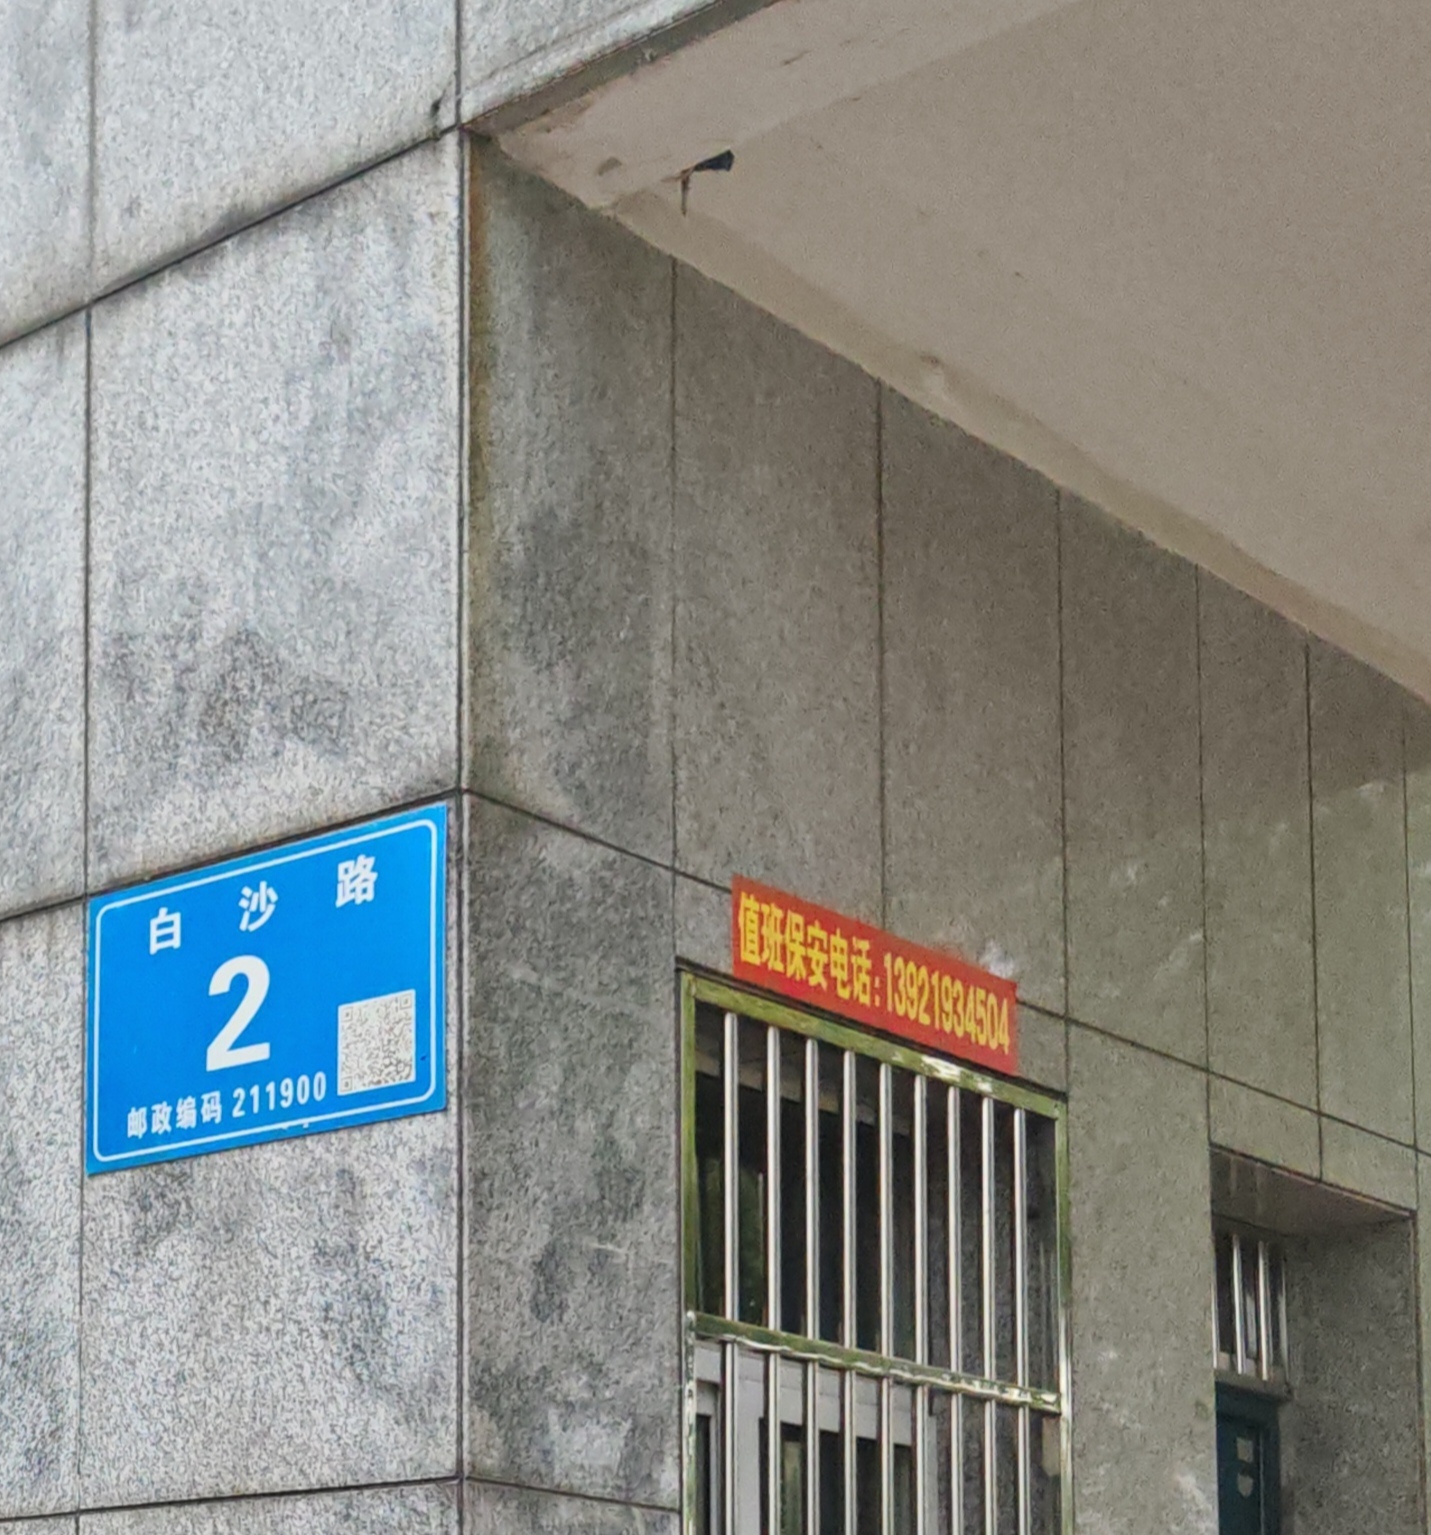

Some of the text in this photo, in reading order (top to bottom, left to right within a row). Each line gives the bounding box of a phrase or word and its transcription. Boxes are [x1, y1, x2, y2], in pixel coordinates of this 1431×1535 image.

[149, 855, 378, 955] 白沙路
[206, 955, 270, 1072] 2
[126, 1071, 327, 1139] 邮政编码 211900
